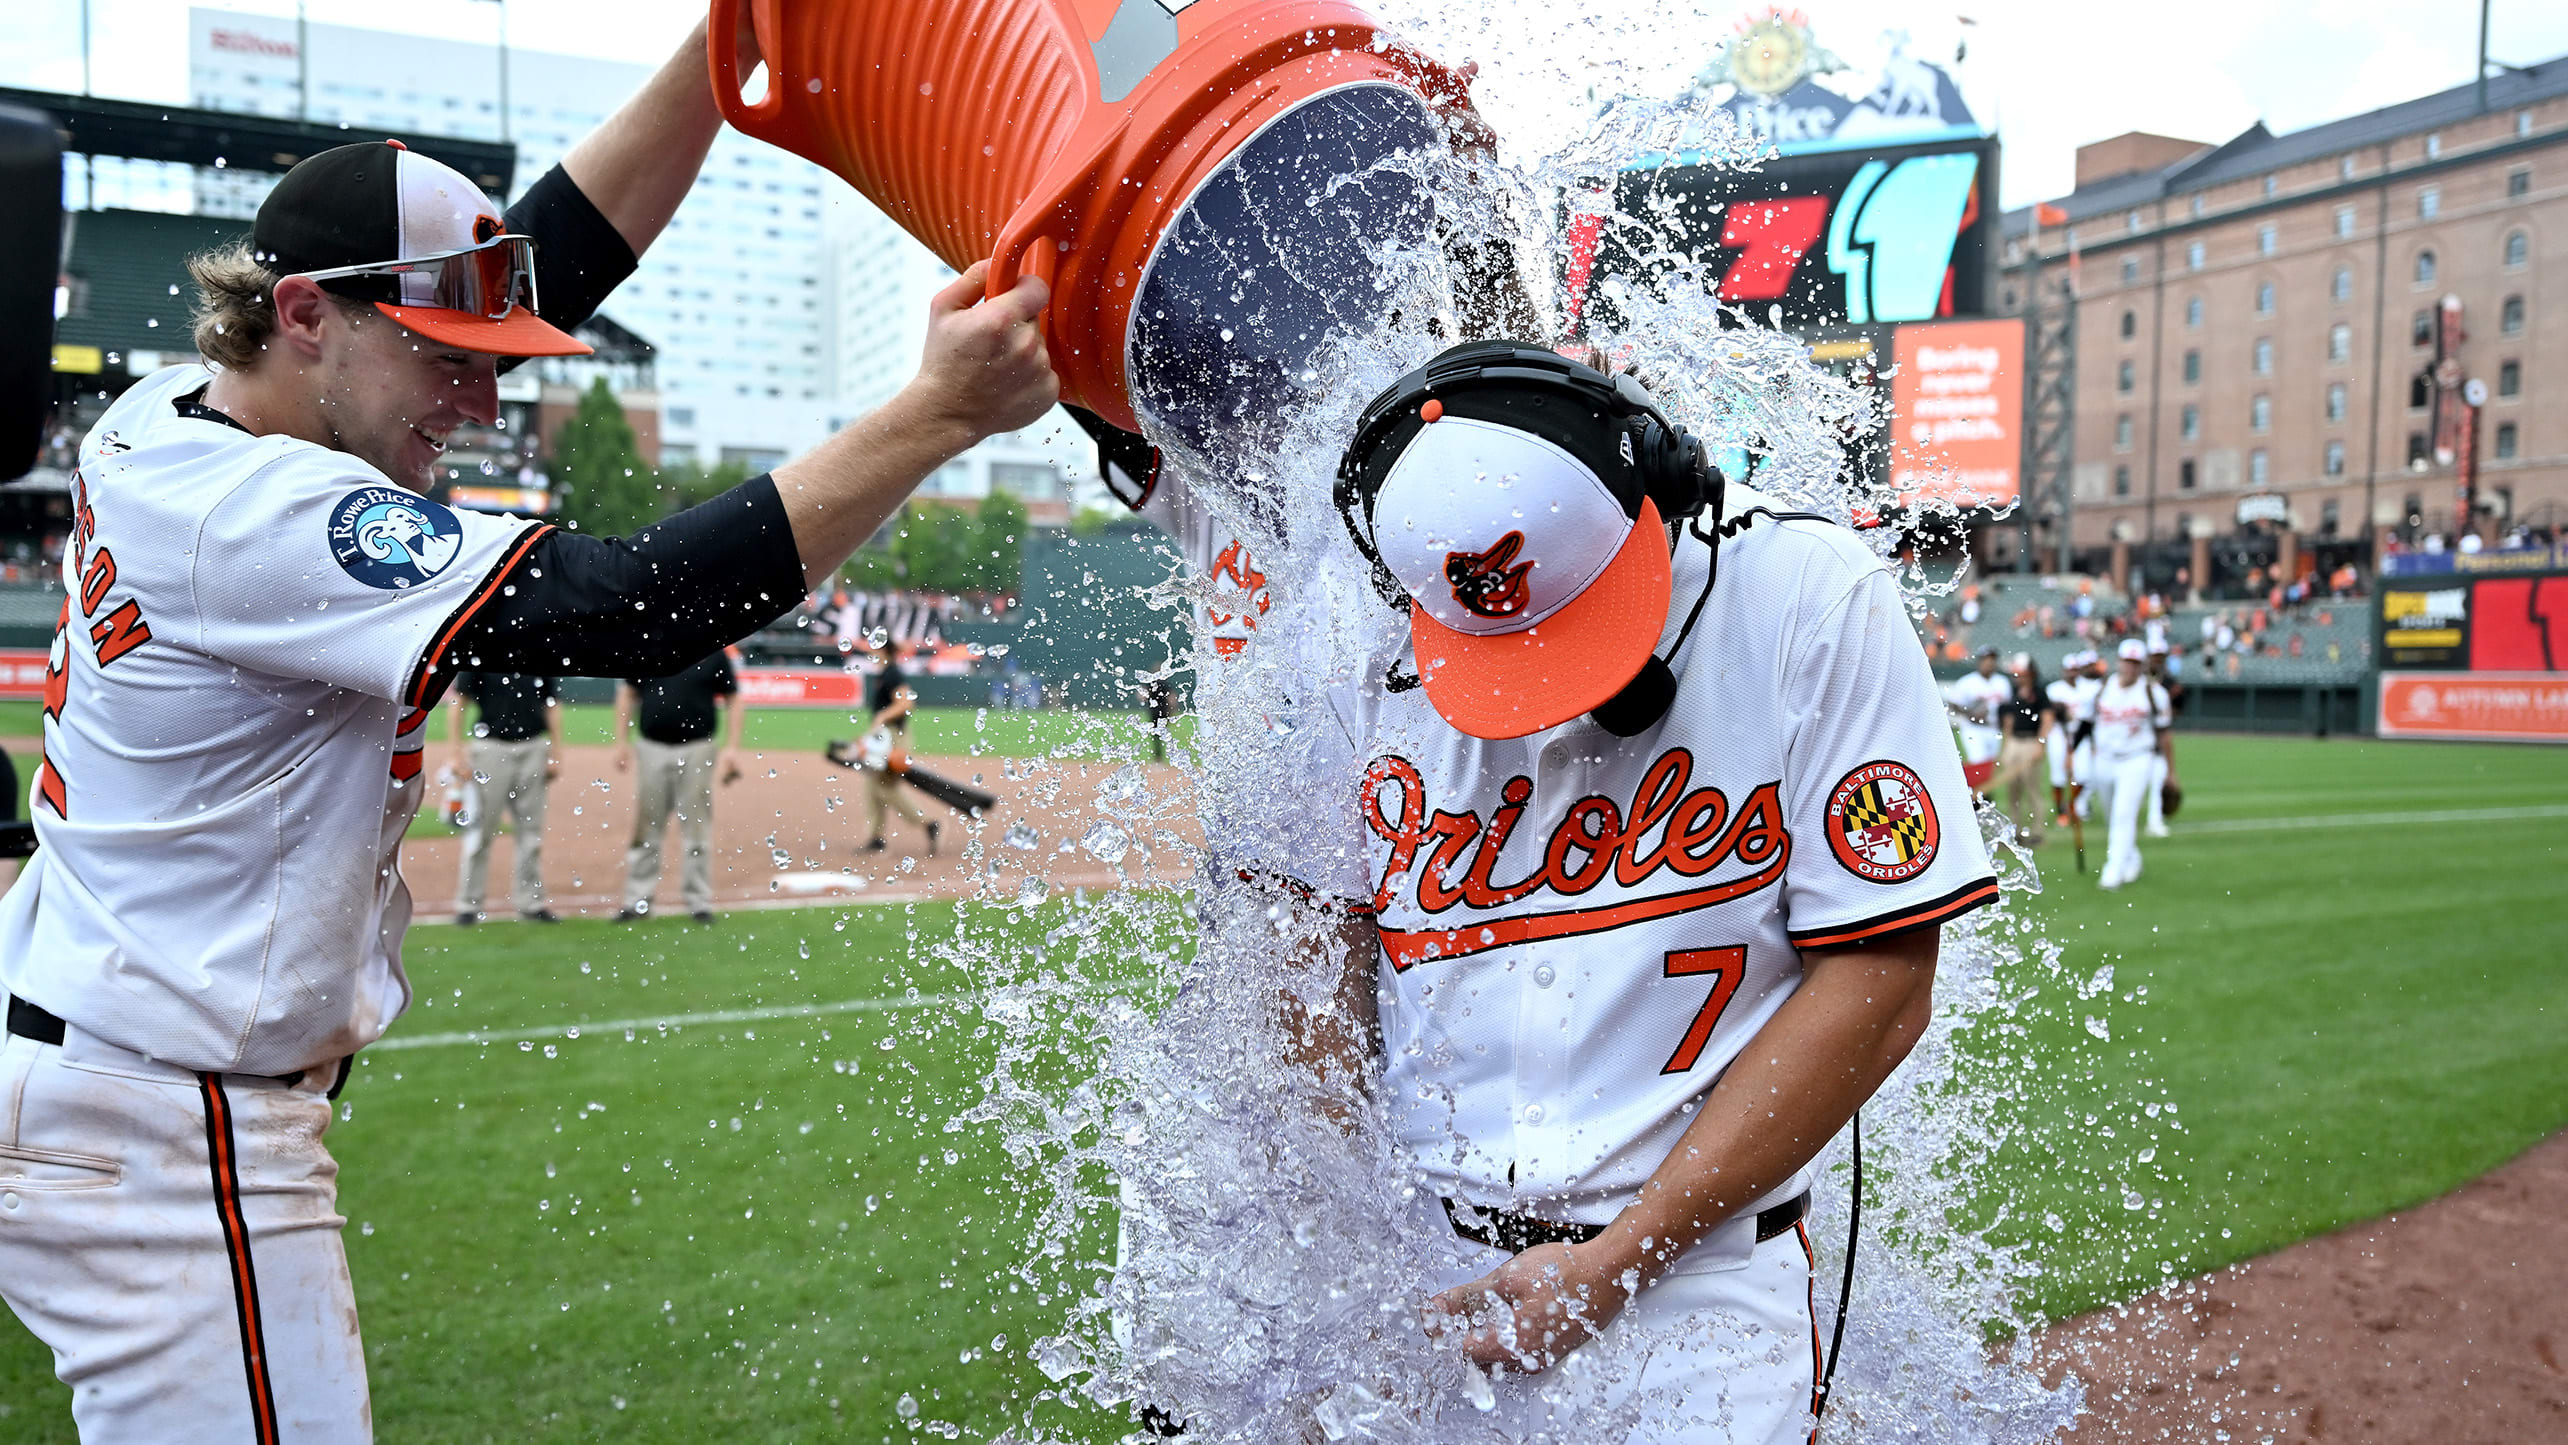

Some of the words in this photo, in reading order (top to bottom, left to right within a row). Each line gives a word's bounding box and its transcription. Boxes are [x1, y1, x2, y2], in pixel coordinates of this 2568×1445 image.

[333, 497, 370, 540] Rowe
[364, 489, 415, 507] Price
[1831, 766, 1923, 816] BALTIMORE
[1361, 747, 1790, 914] Orioles
[1858, 844, 1933, 878] ORIOLES
[1660, 944, 1748, 1076] 7
